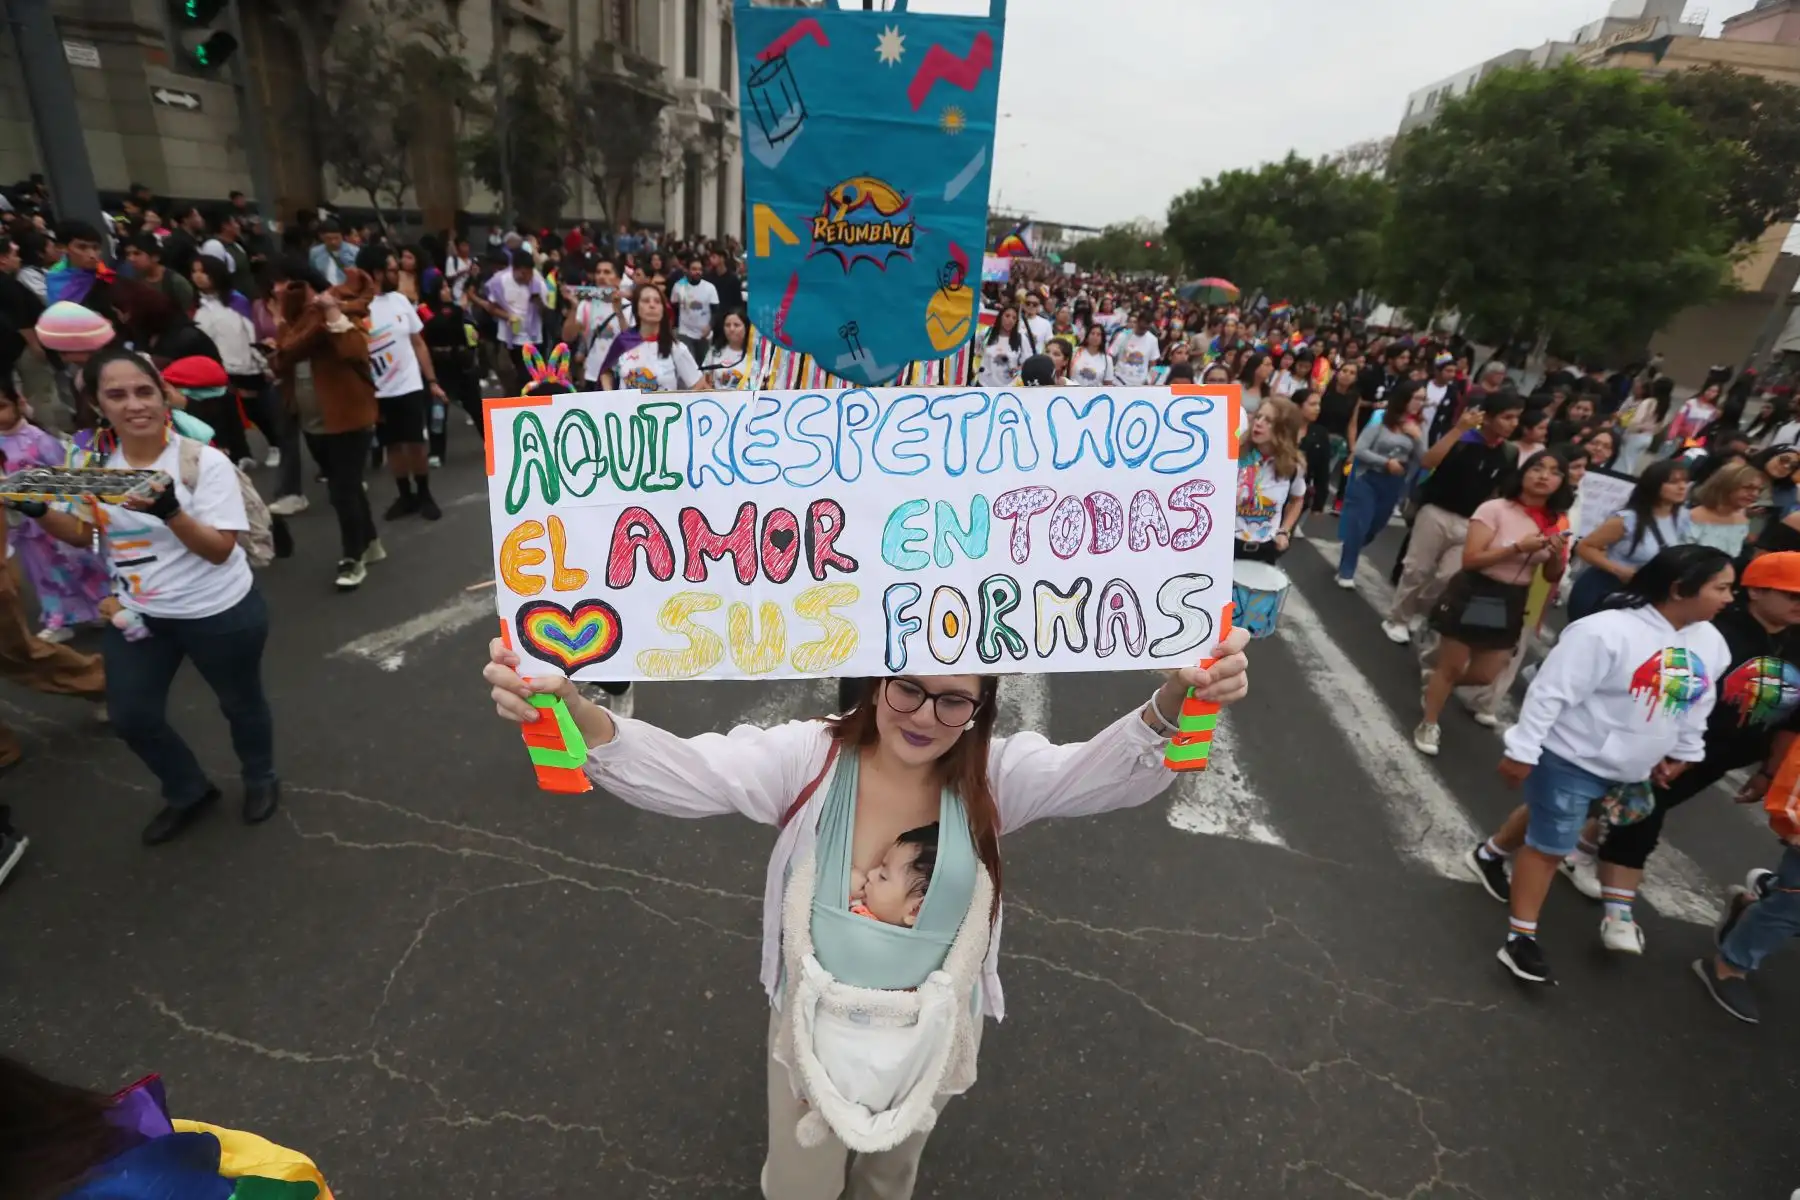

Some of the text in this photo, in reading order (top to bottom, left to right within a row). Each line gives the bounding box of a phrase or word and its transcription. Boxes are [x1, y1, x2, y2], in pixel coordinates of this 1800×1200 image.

[813, 216, 913, 246] RETUMBAYÁ
[505, 388, 1214, 515] AQUI RESPETAMOS
[500, 479, 1215, 596] EL AMOR EN TODAS
[634, 573, 1213, 679] SUS FORMAS
